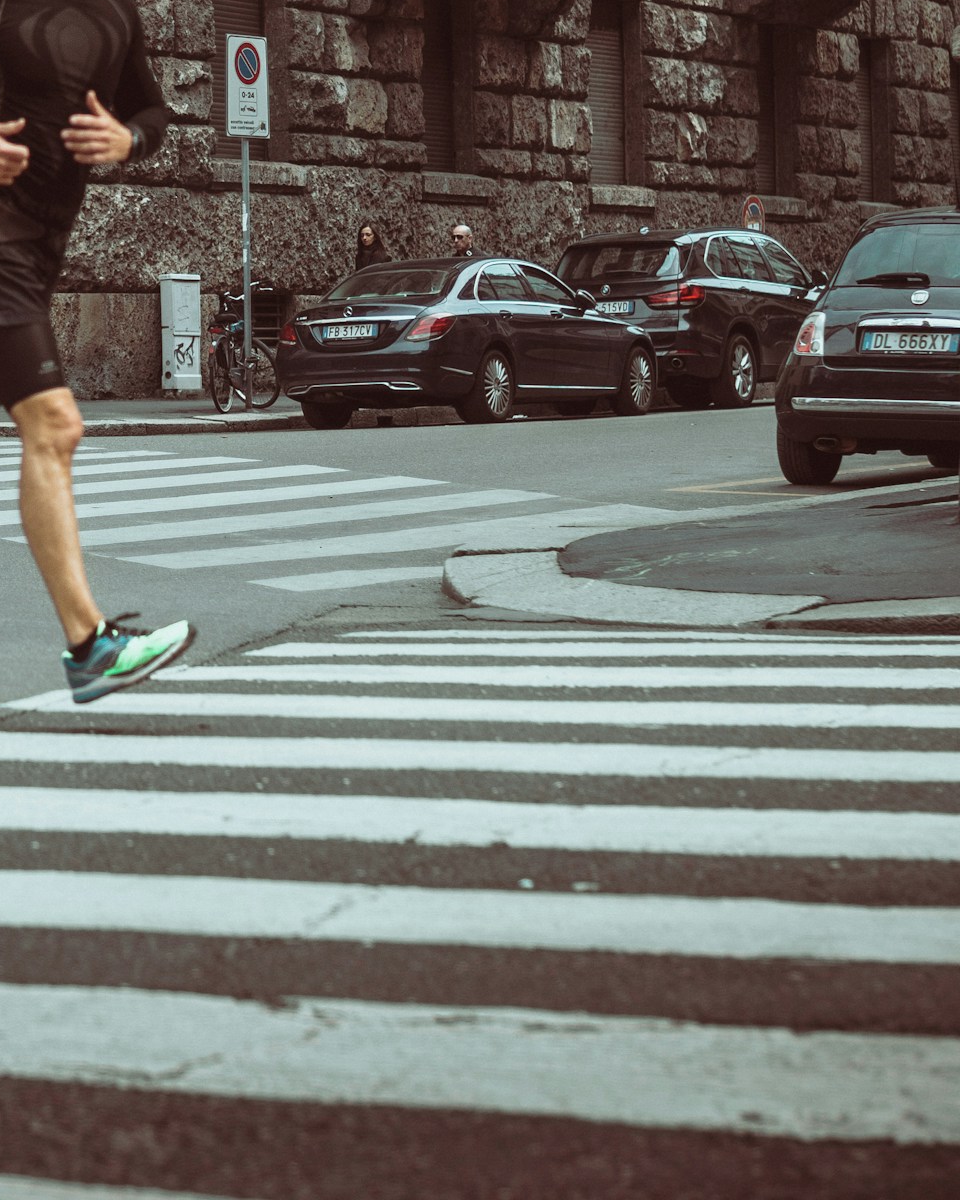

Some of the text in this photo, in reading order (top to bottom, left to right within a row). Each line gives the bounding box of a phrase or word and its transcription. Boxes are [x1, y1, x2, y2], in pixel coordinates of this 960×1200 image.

[241, 91, 255, 99] 0-24
[328, 325, 372, 338] FB 317CV
[873, 333, 949, 350] DL 666XY
